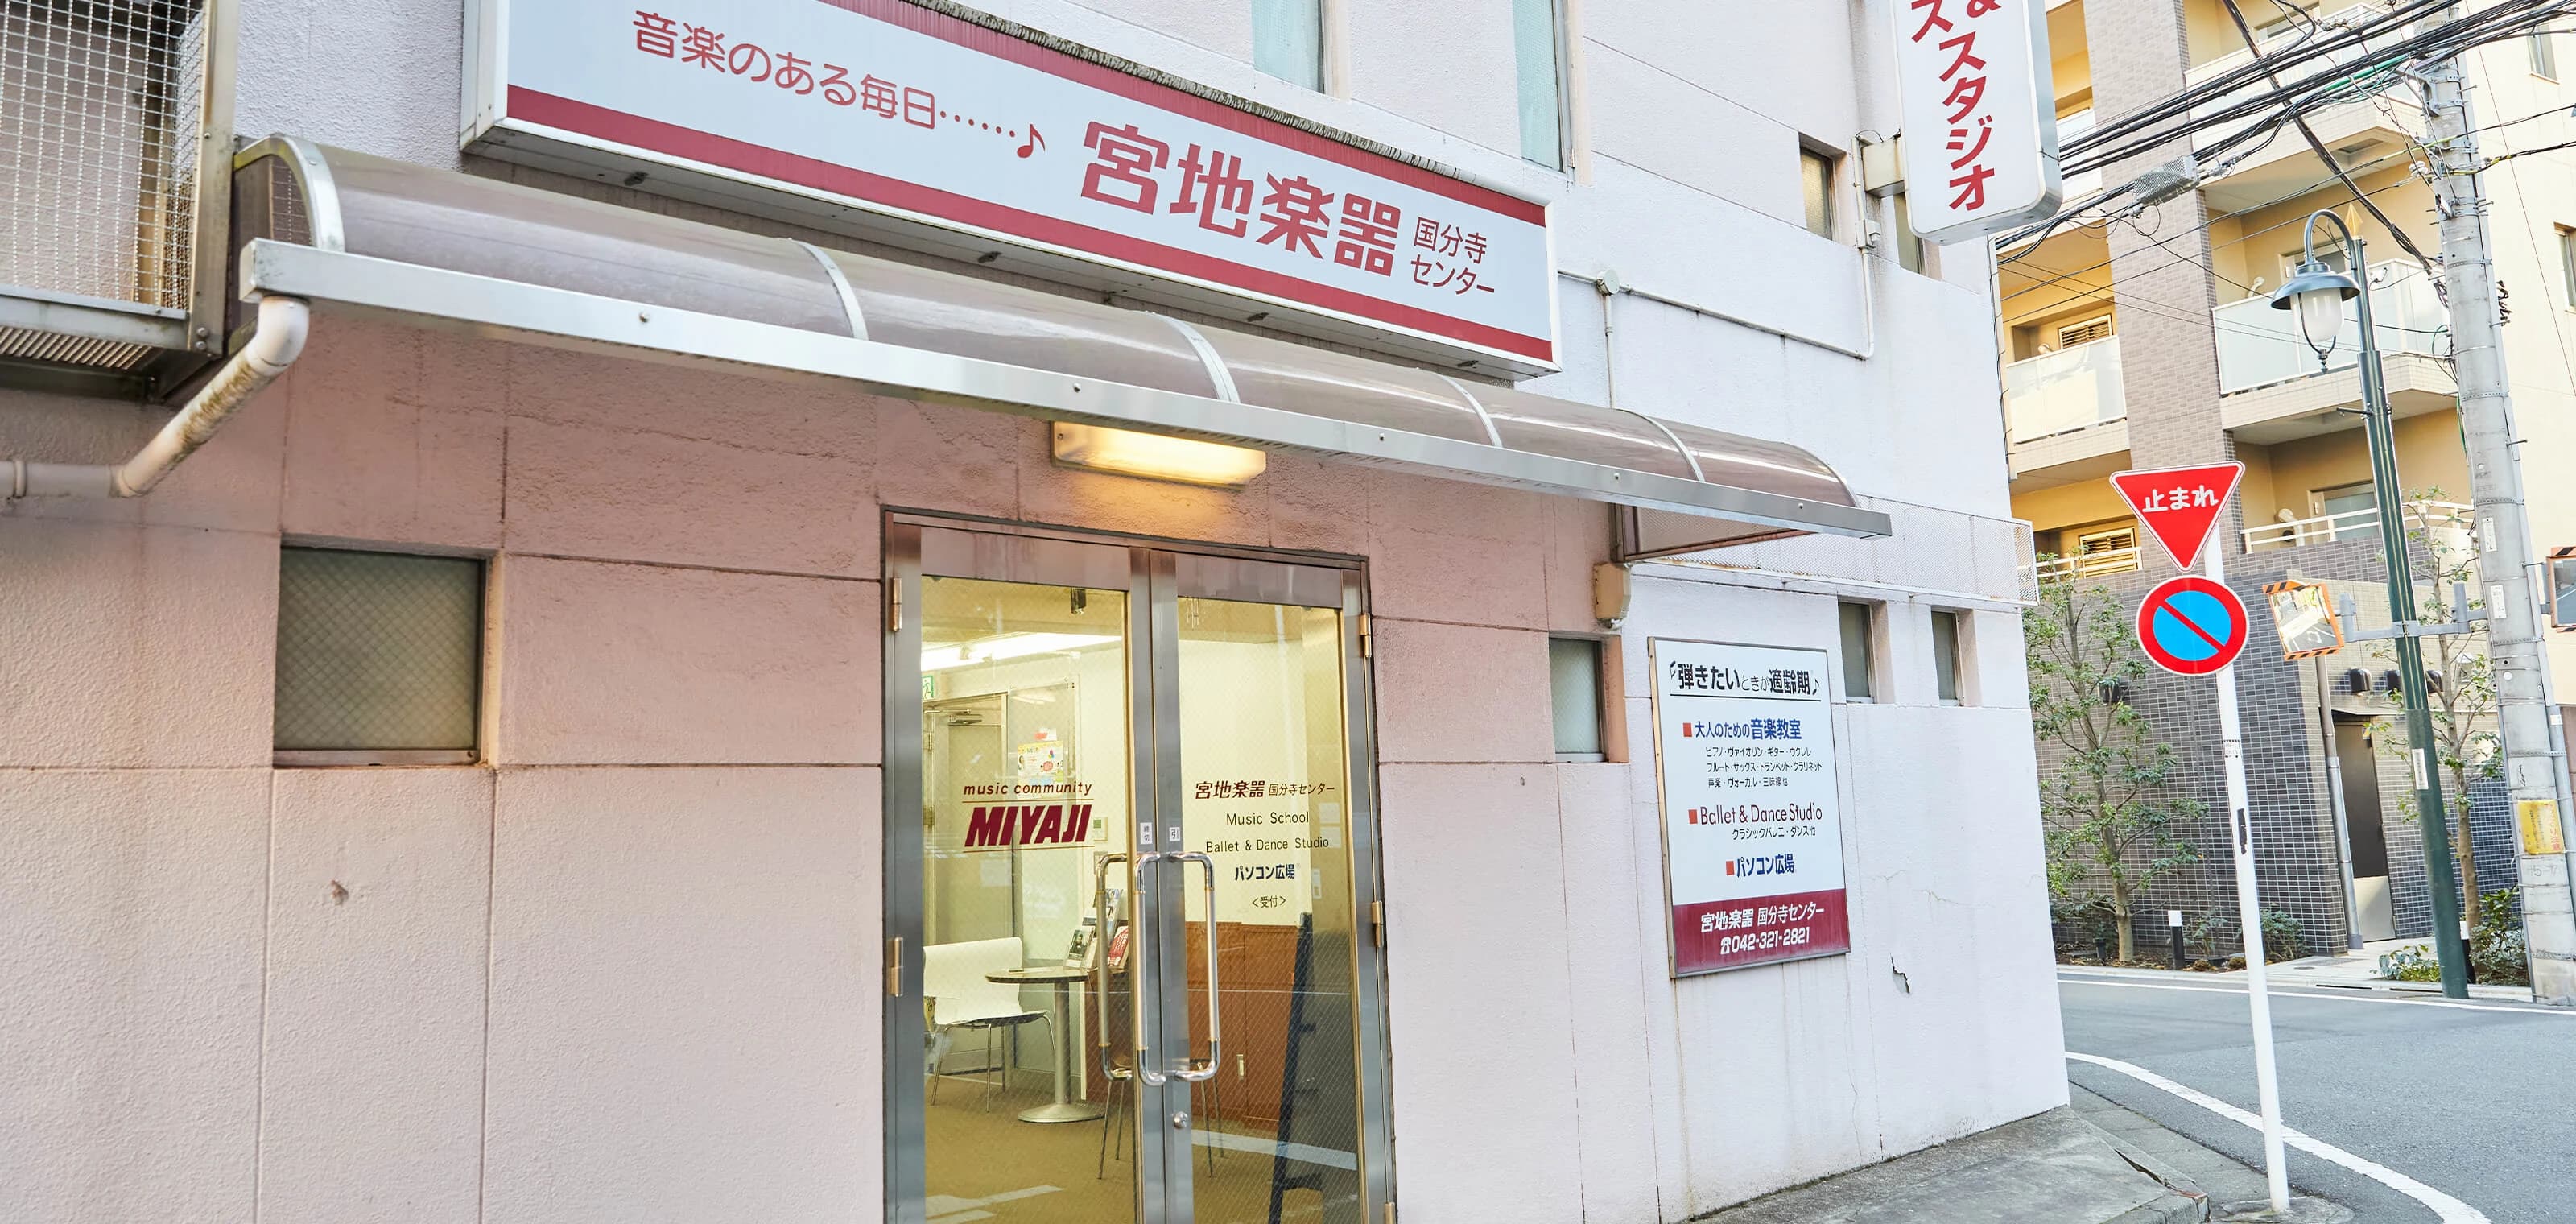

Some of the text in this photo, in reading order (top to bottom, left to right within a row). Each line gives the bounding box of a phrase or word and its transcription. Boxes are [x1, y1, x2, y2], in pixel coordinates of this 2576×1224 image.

[1938, 31, 1995, 211] スタジオ
[1080, 121, 1402, 277] 宮地楽器
[1413, 216, 1488, 264] 国分寺
[1410, 254, 1496, 296] センター
[2142, 485, 2219, 513] 止まれ
[1678, 663, 1811, 695] 弾きたいときが適齢期
[1695, 718, 1802, 740] 大人のための音楽教室
[964, 781, 1092, 796] music community
[1195, 780, 1335, 800] 宮地楽器 国分寺センター
[964, 804, 1092, 847] MIYAJI
[1226, 811, 1309, 825] Music School
[1700, 801, 1823, 825] Ballet & Dance Studio
[1206, 837, 1329, 854] Ballet & Dance Studio
[1234, 863, 1295, 881] パソコン広場
[1736, 854, 1794, 879] パソコン広場
[1700, 901, 1825, 933] 宮地楽器 国分寺センター
[1732, 927, 1810, 952] 042-321-2821
